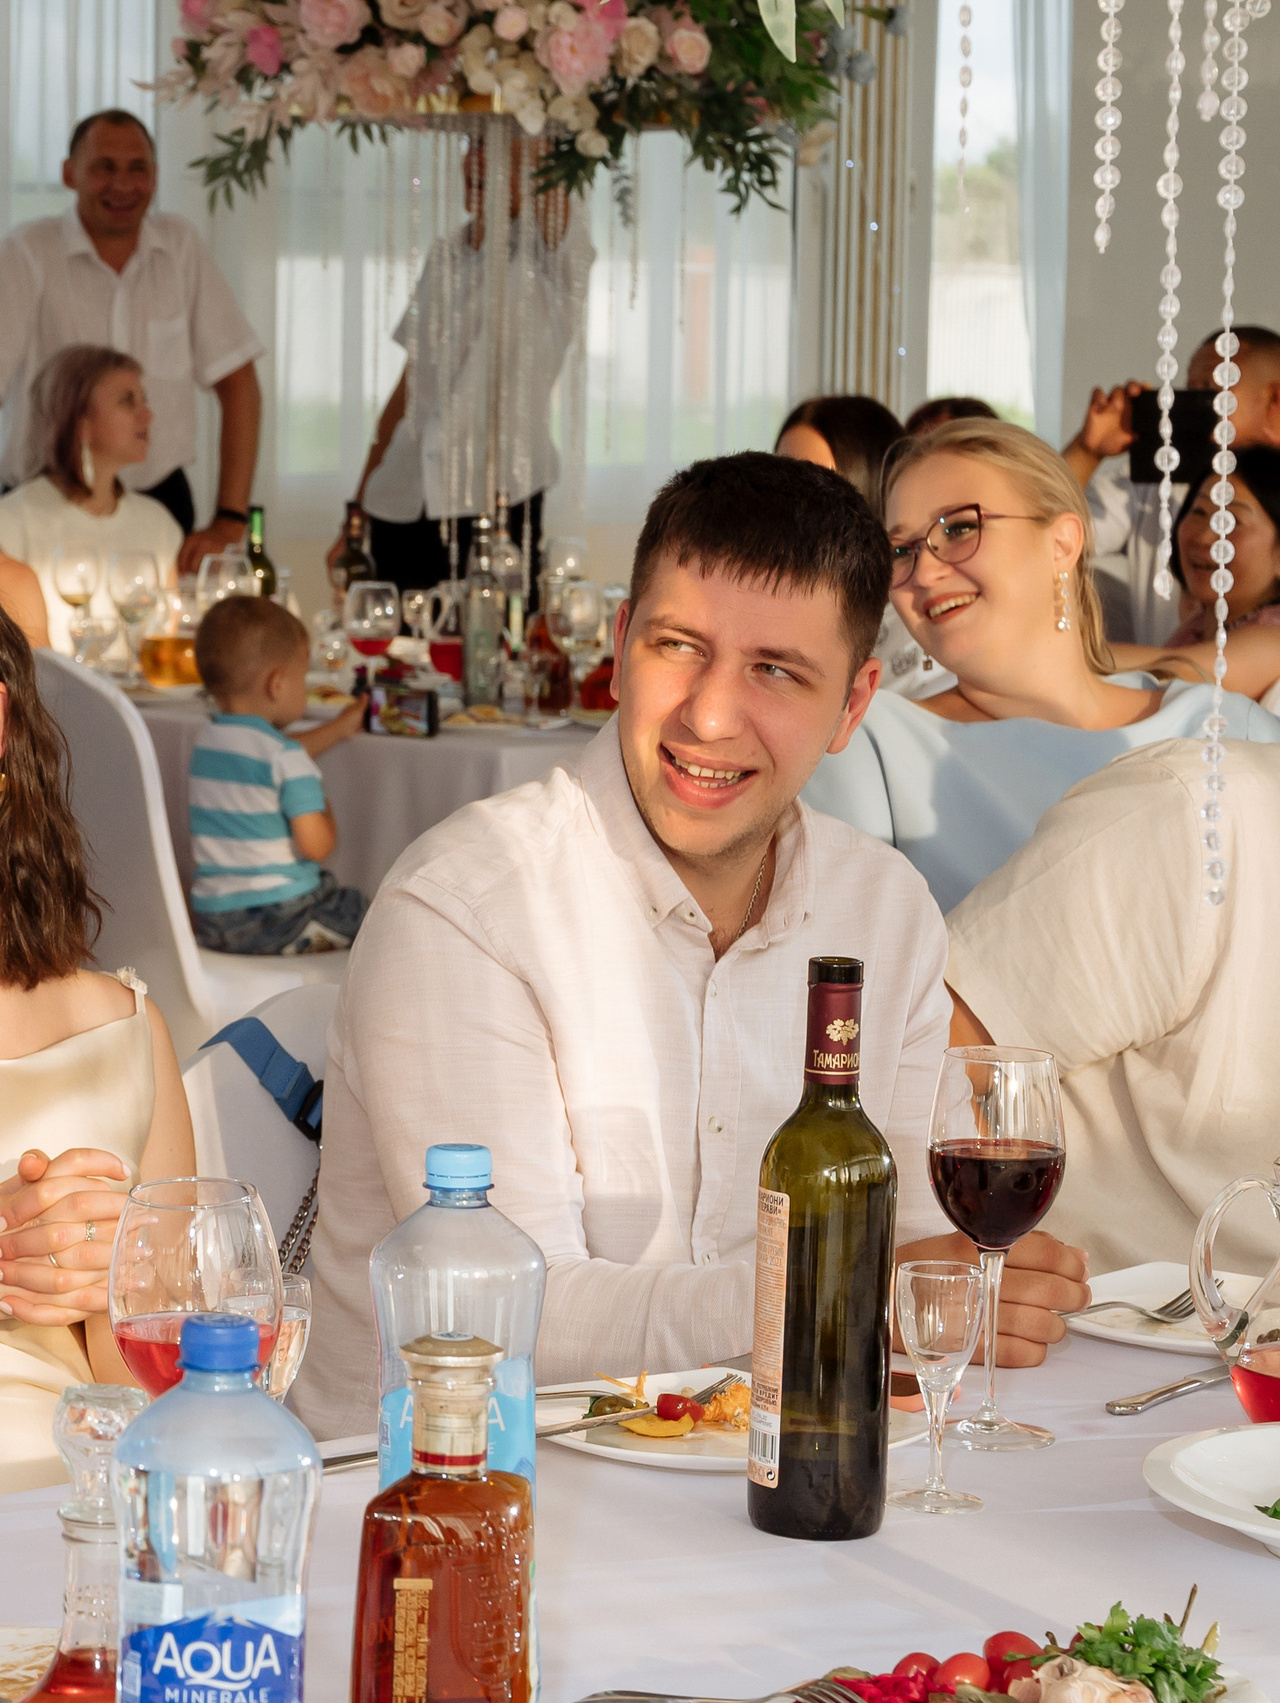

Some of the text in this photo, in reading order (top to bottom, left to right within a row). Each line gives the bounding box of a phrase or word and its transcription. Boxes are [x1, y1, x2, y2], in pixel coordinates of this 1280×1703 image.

[813, 1049, 860, 1069] ТАМАРИО
[152, 1632, 281, 1691] AQUA
[164, 1687, 269, 1703] MINERALE
